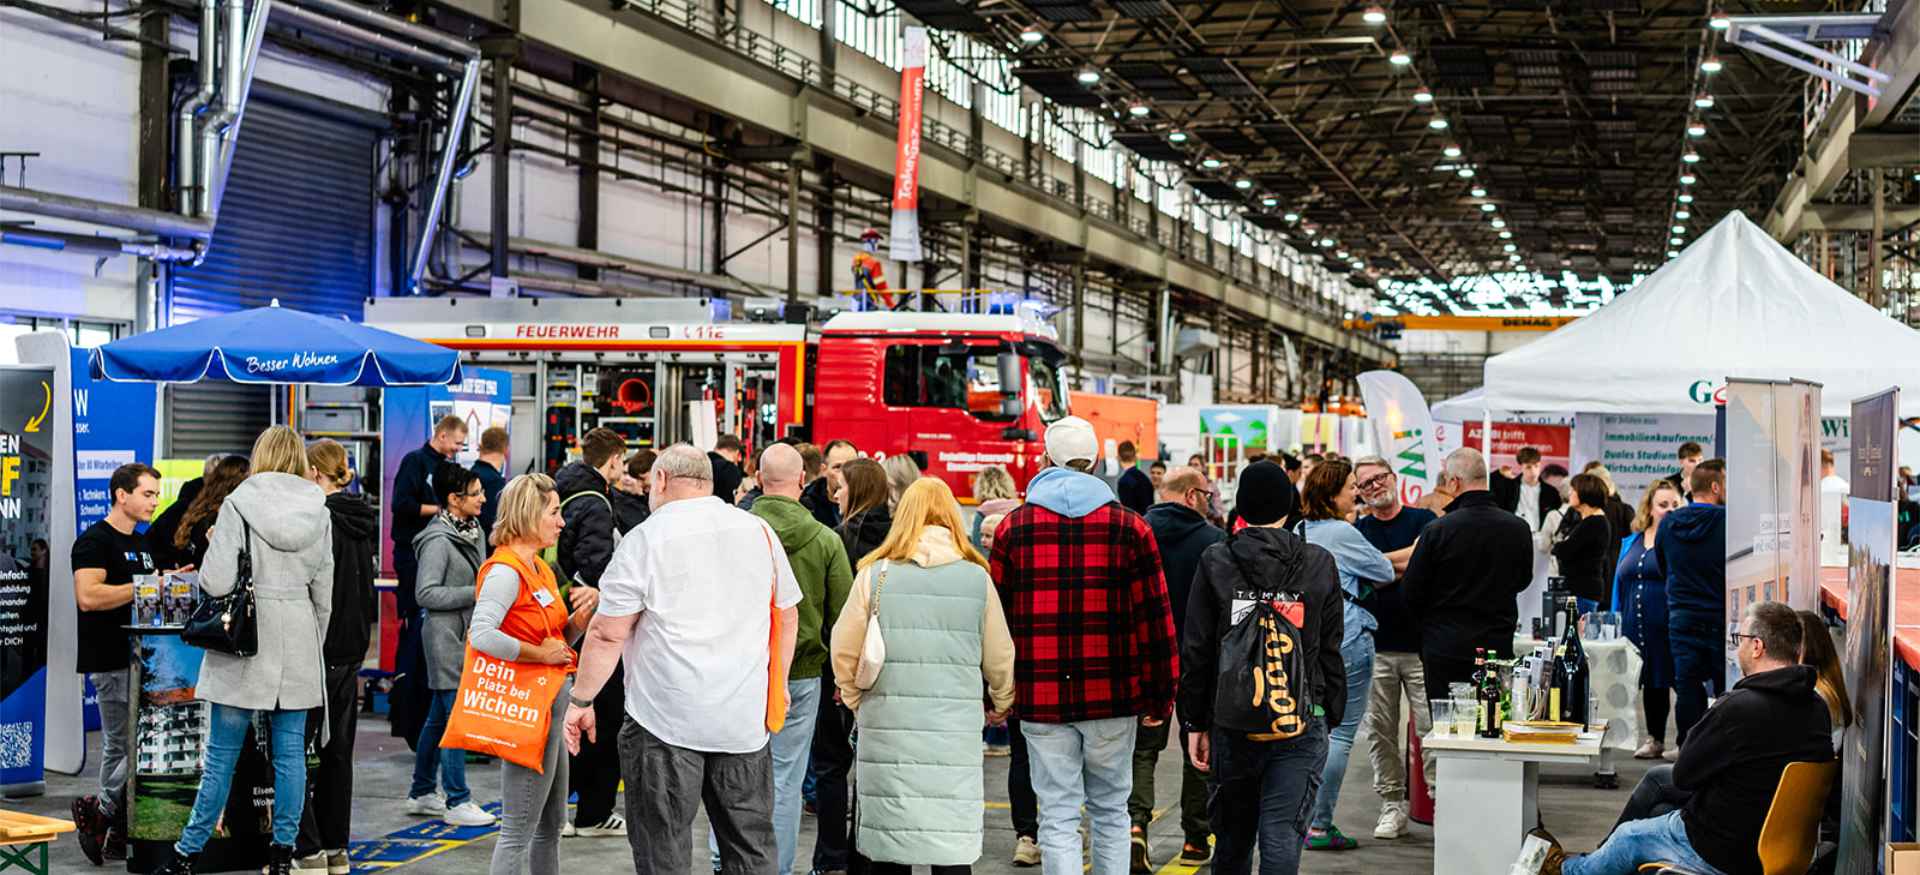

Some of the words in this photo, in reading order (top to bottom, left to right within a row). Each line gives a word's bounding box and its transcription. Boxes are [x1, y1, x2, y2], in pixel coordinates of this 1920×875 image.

[1503, 318, 1552, 327] DEMAG
[516, 325, 619, 337] FEUERWEHR
[246, 356, 288, 373] Besser
[292, 351, 338, 368] Wohnen
[1604, 449, 1634, 459] Duales
[1637, 450, 1677, 460] Studium
[24, 622, 37, 632] und
[4, 637, 24, 646] DICH
[473, 656, 515, 681] Dein
[477, 677, 507, 694] Platz
[510, 683, 531, 700] bei
[464, 688, 539, 721] Wichern
